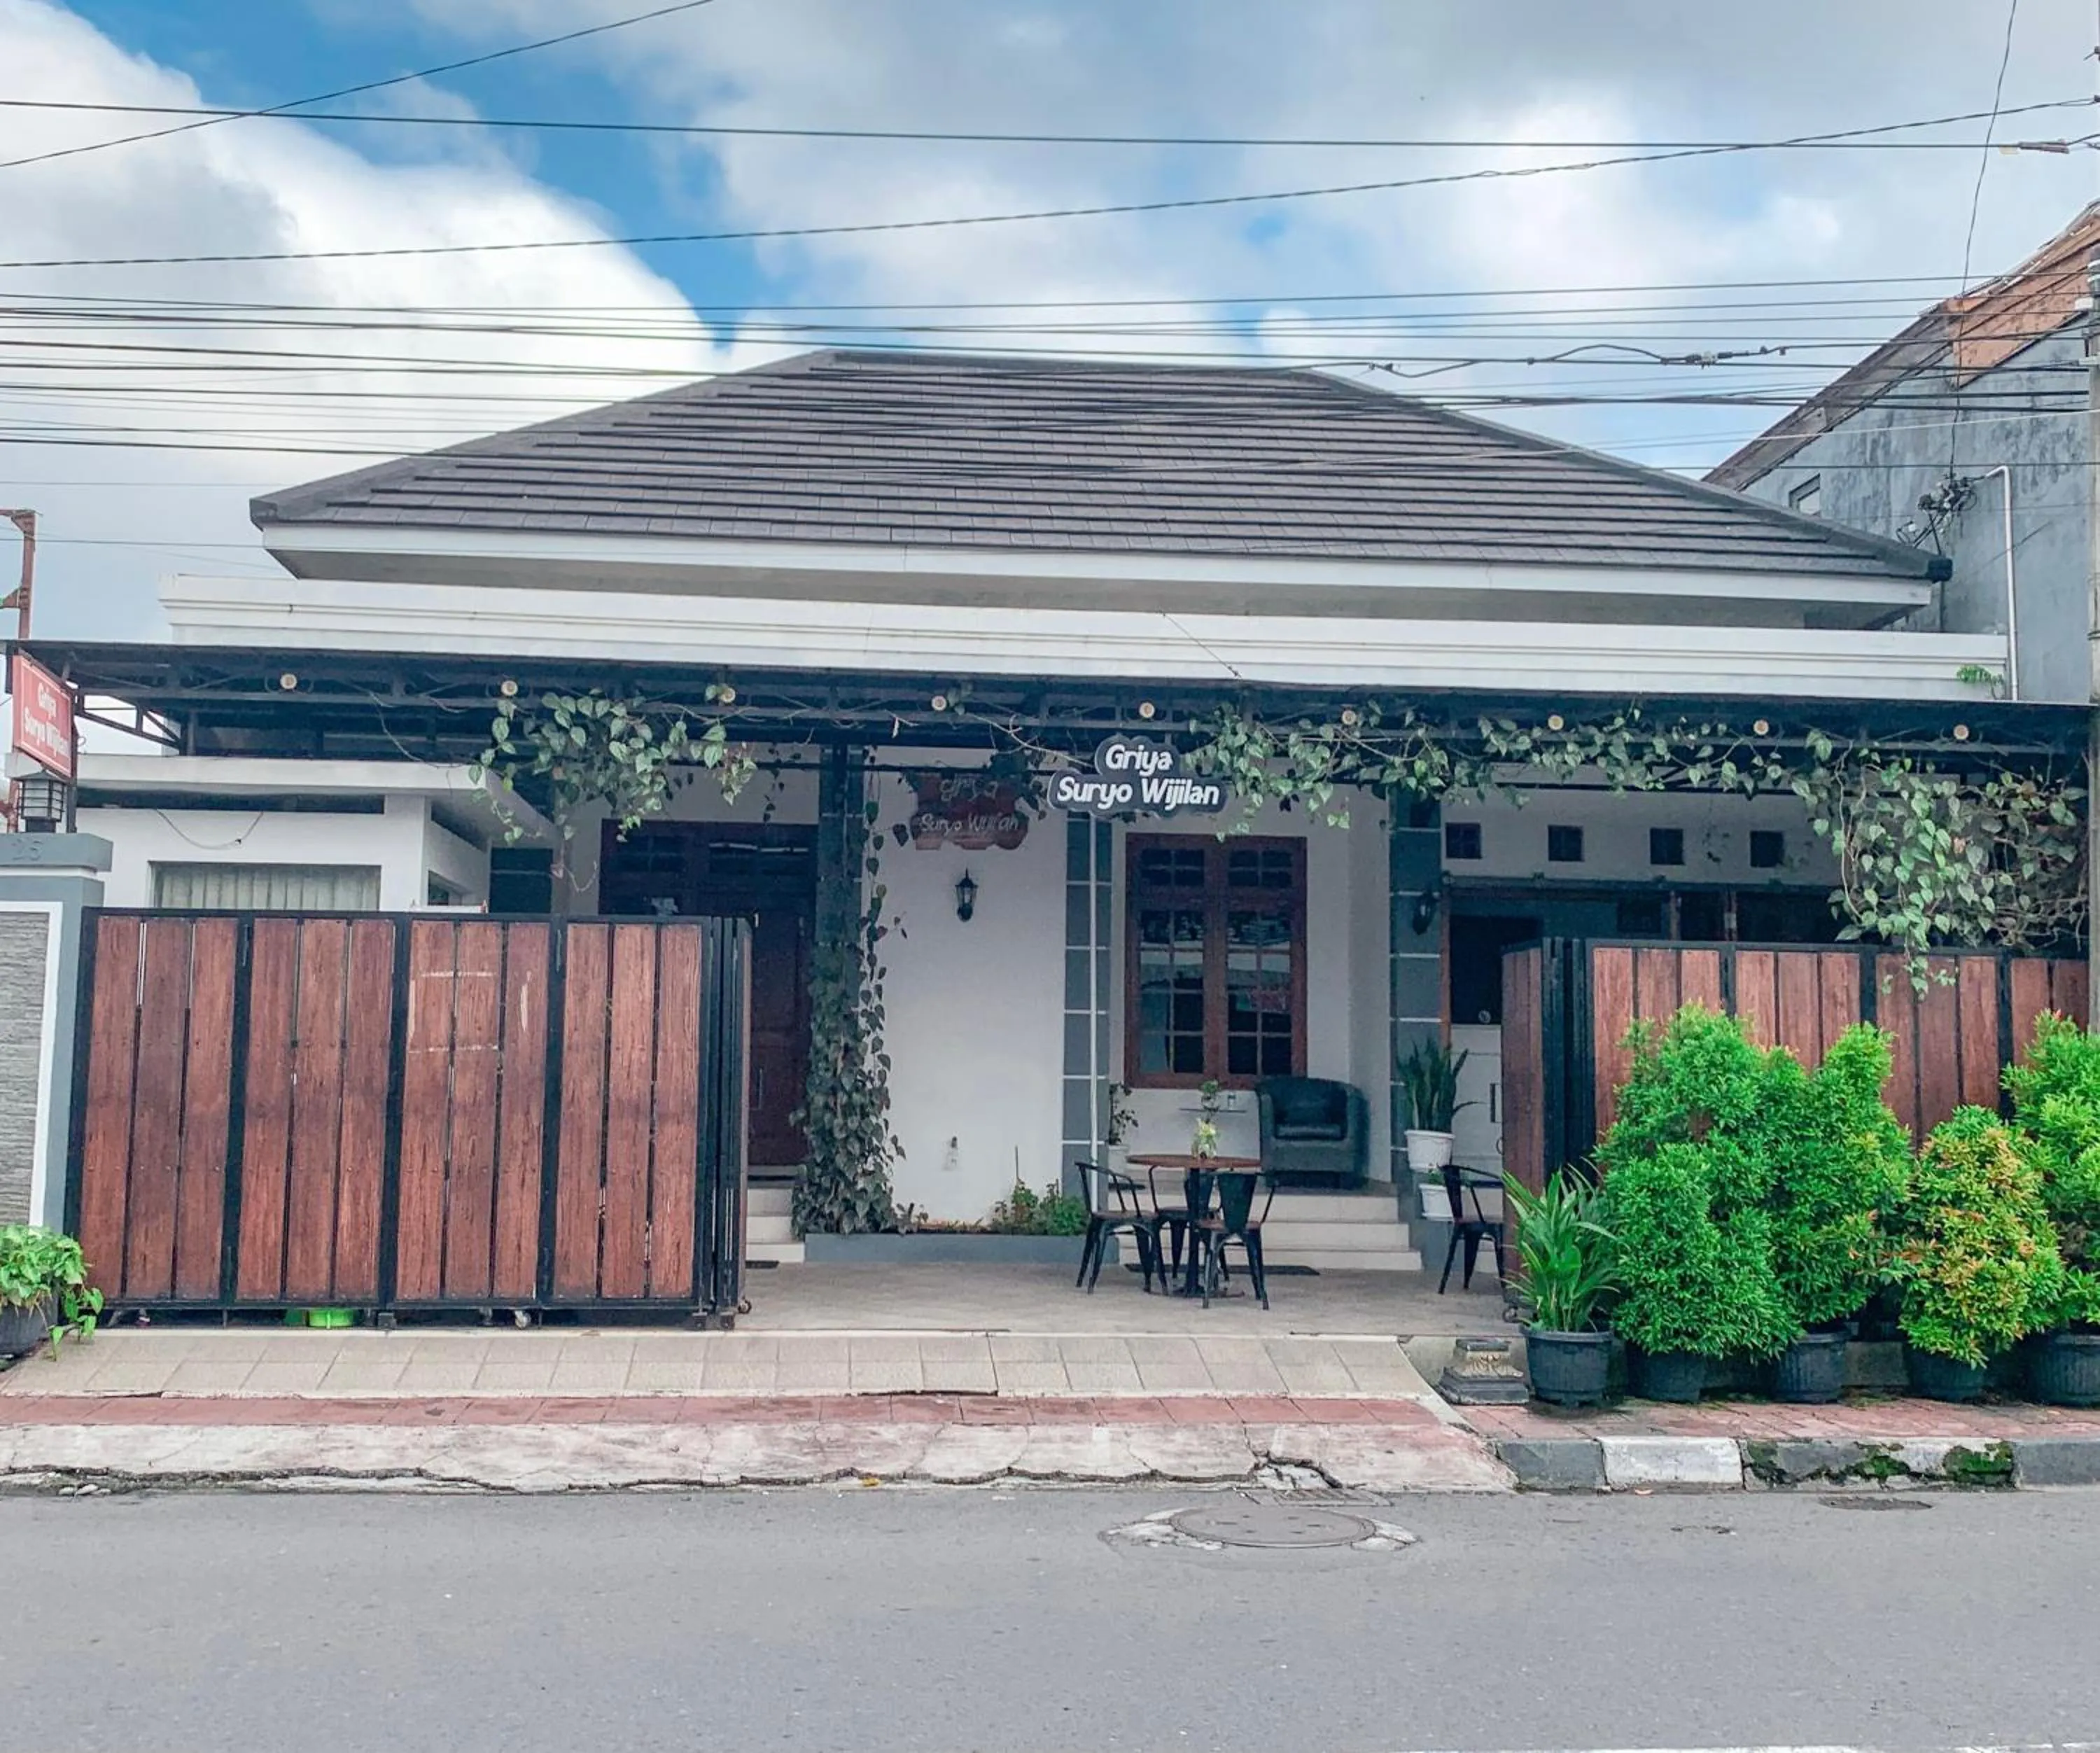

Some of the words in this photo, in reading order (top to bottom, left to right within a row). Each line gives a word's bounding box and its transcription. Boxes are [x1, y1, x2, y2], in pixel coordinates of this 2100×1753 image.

[1105, 744, 1173, 777] Griya
[1057, 776, 1133, 810] Suryo
[1141, 777, 1220, 811] Wijilan
